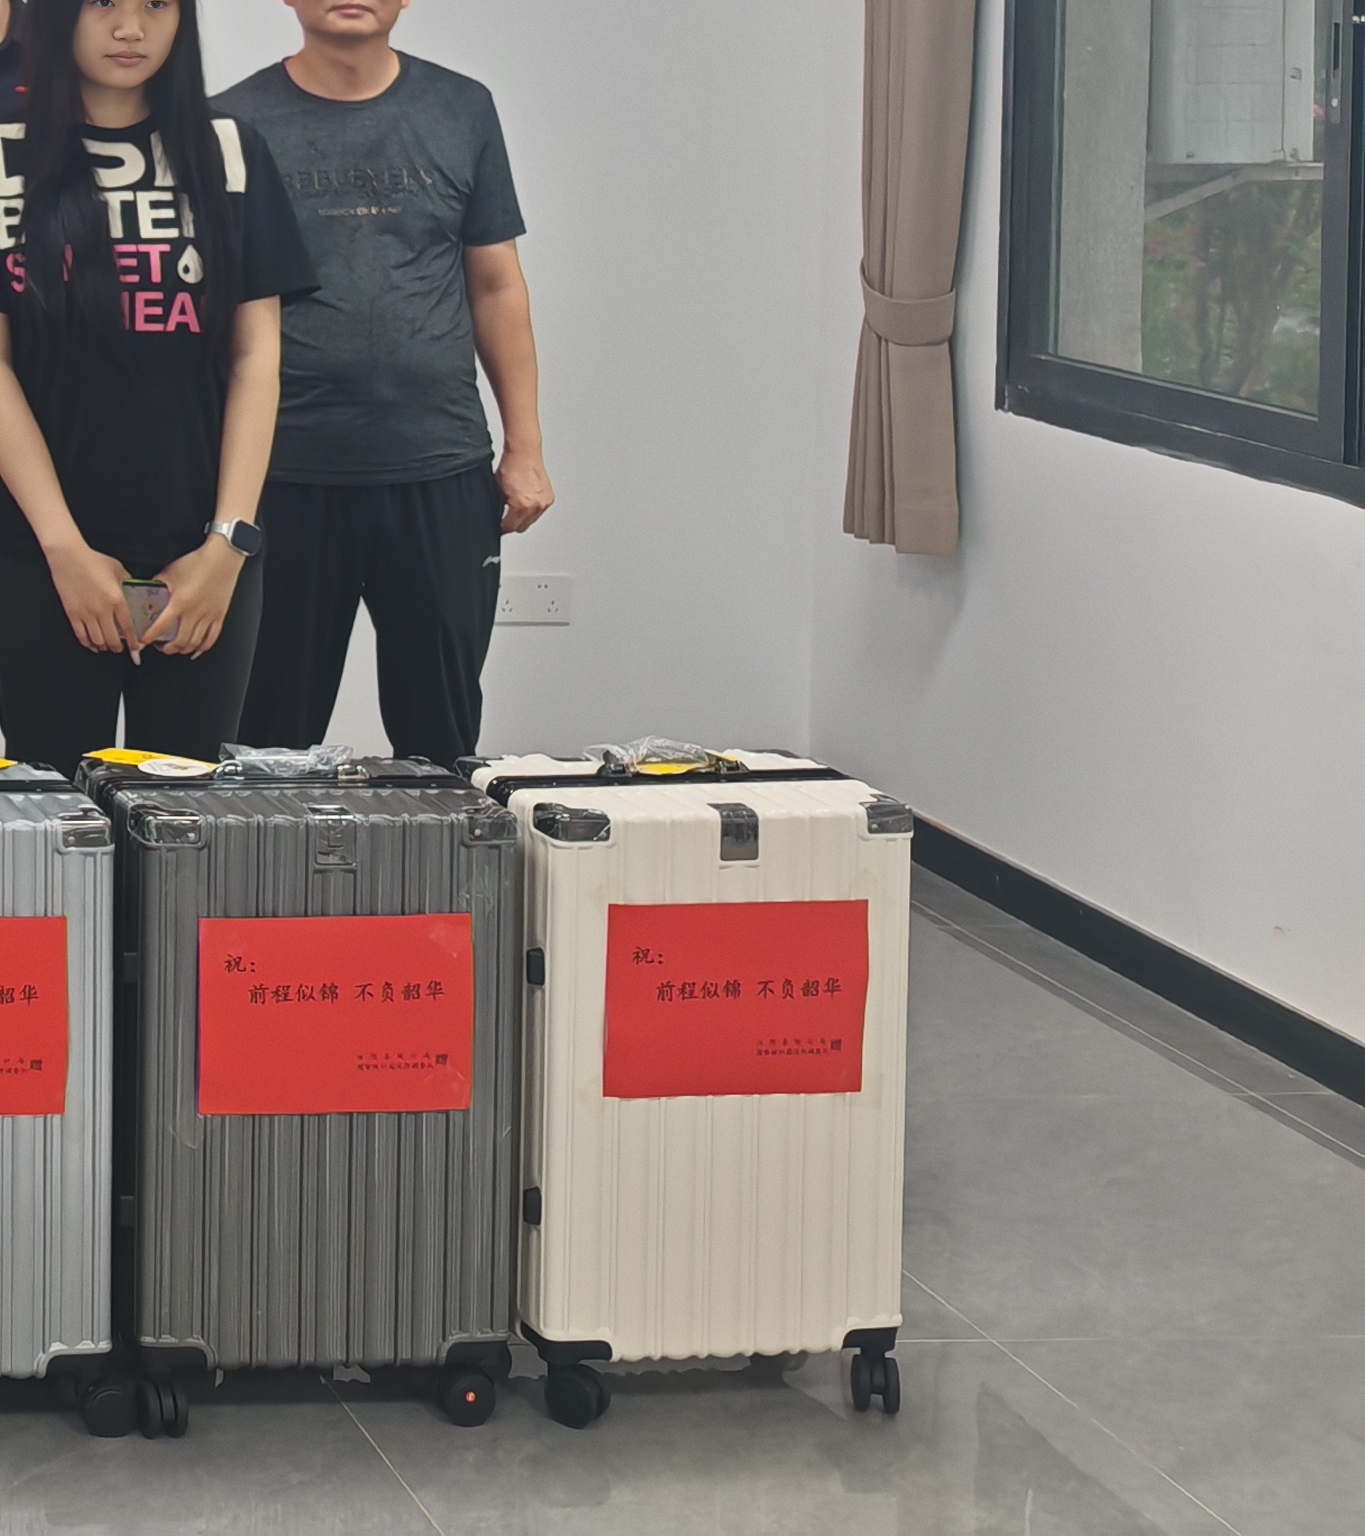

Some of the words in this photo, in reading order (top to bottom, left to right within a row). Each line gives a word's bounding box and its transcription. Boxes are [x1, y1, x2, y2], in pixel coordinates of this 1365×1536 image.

[248, 982, 339, 1006] 前程似锦
[354, 980, 445, 1003] 不负韶华
[656, 979, 742, 1003] 前程似锦
[757, 977, 842, 1000] 不负韶华
